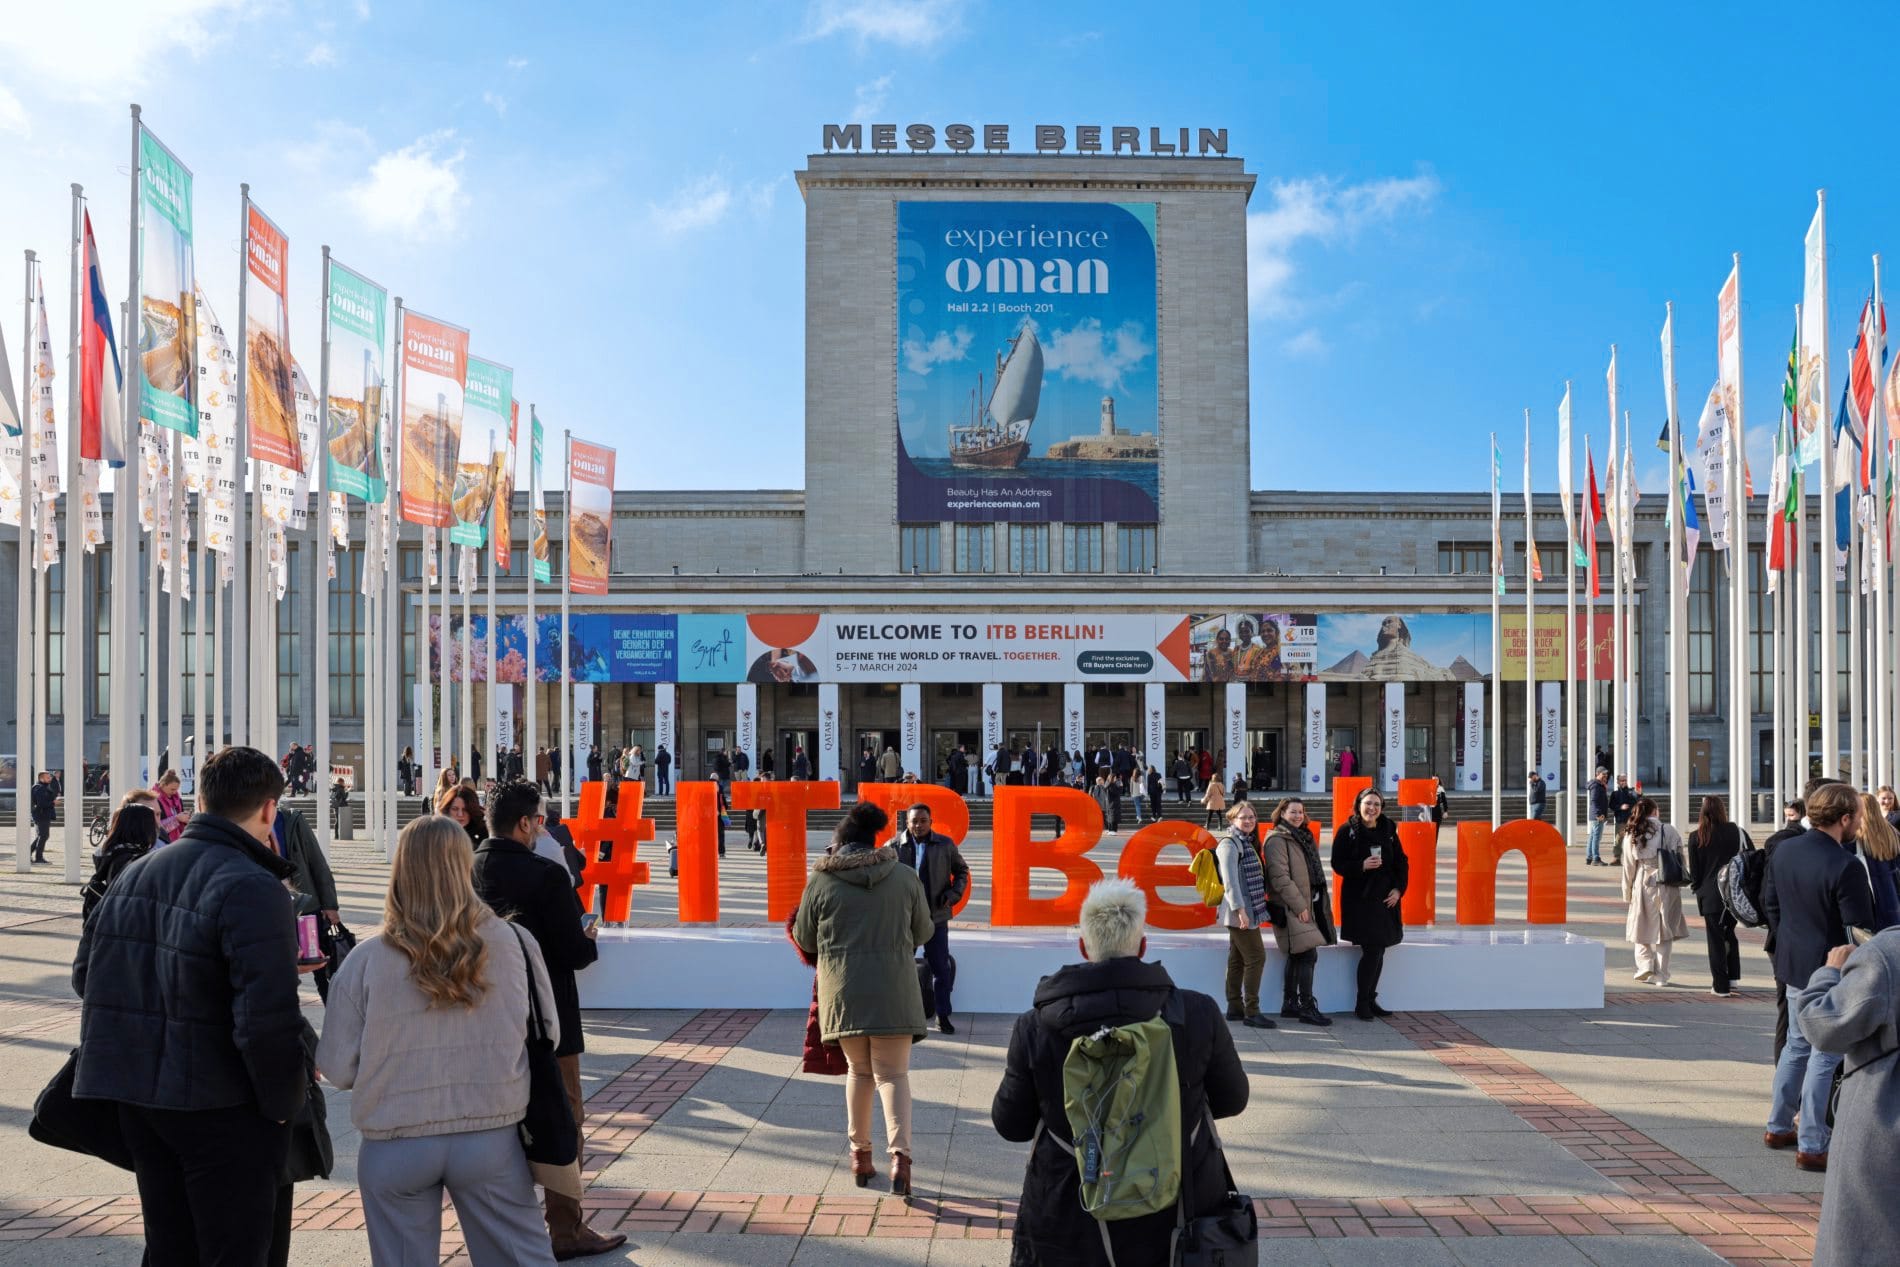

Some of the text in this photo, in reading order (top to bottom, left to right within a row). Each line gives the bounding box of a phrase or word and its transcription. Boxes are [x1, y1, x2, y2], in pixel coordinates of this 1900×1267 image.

[823, 124, 1229, 152] MESSE BERLIN
[945, 224, 1109, 253] experience
[249, 238, 279, 275] oman
[945, 257, 1109, 294] oman
[333, 292, 374, 324] oman
[947, 303, 969, 313] Hall
[971, 303, 989, 313] 2.2
[998, 303, 1032, 313] Booth
[1034, 303, 1054, 313] 201
[407, 338, 455, 364] oman
[207, 456, 222, 464] ITB
[574, 459, 606, 475] oman
[280, 487, 294, 495] ITB
[947, 488, 1052, 497] Beauty Has An Address
[947, 500, 1040, 509] experienceoman.om
[215, 514, 228, 523] ITB
[292, 509, 307, 517] ITB
[836, 624, 1104, 640] WELCOME TO ITB BERLIN!
[836, 652, 1061, 660] DEFINE THE WORLD OF TRAVEL. TOGETHER.
[836, 663, 842, 671] 5
[851, 663, 857, 671] 7
[859, 663, 894, 671] MARCH
[896, 663, 918, 671] 2024
[1232, 720, 1240, 749] QATAR
[1312, 720, 1320, 749] QATAR
[1547, 718, 1555, 747] QATAR
